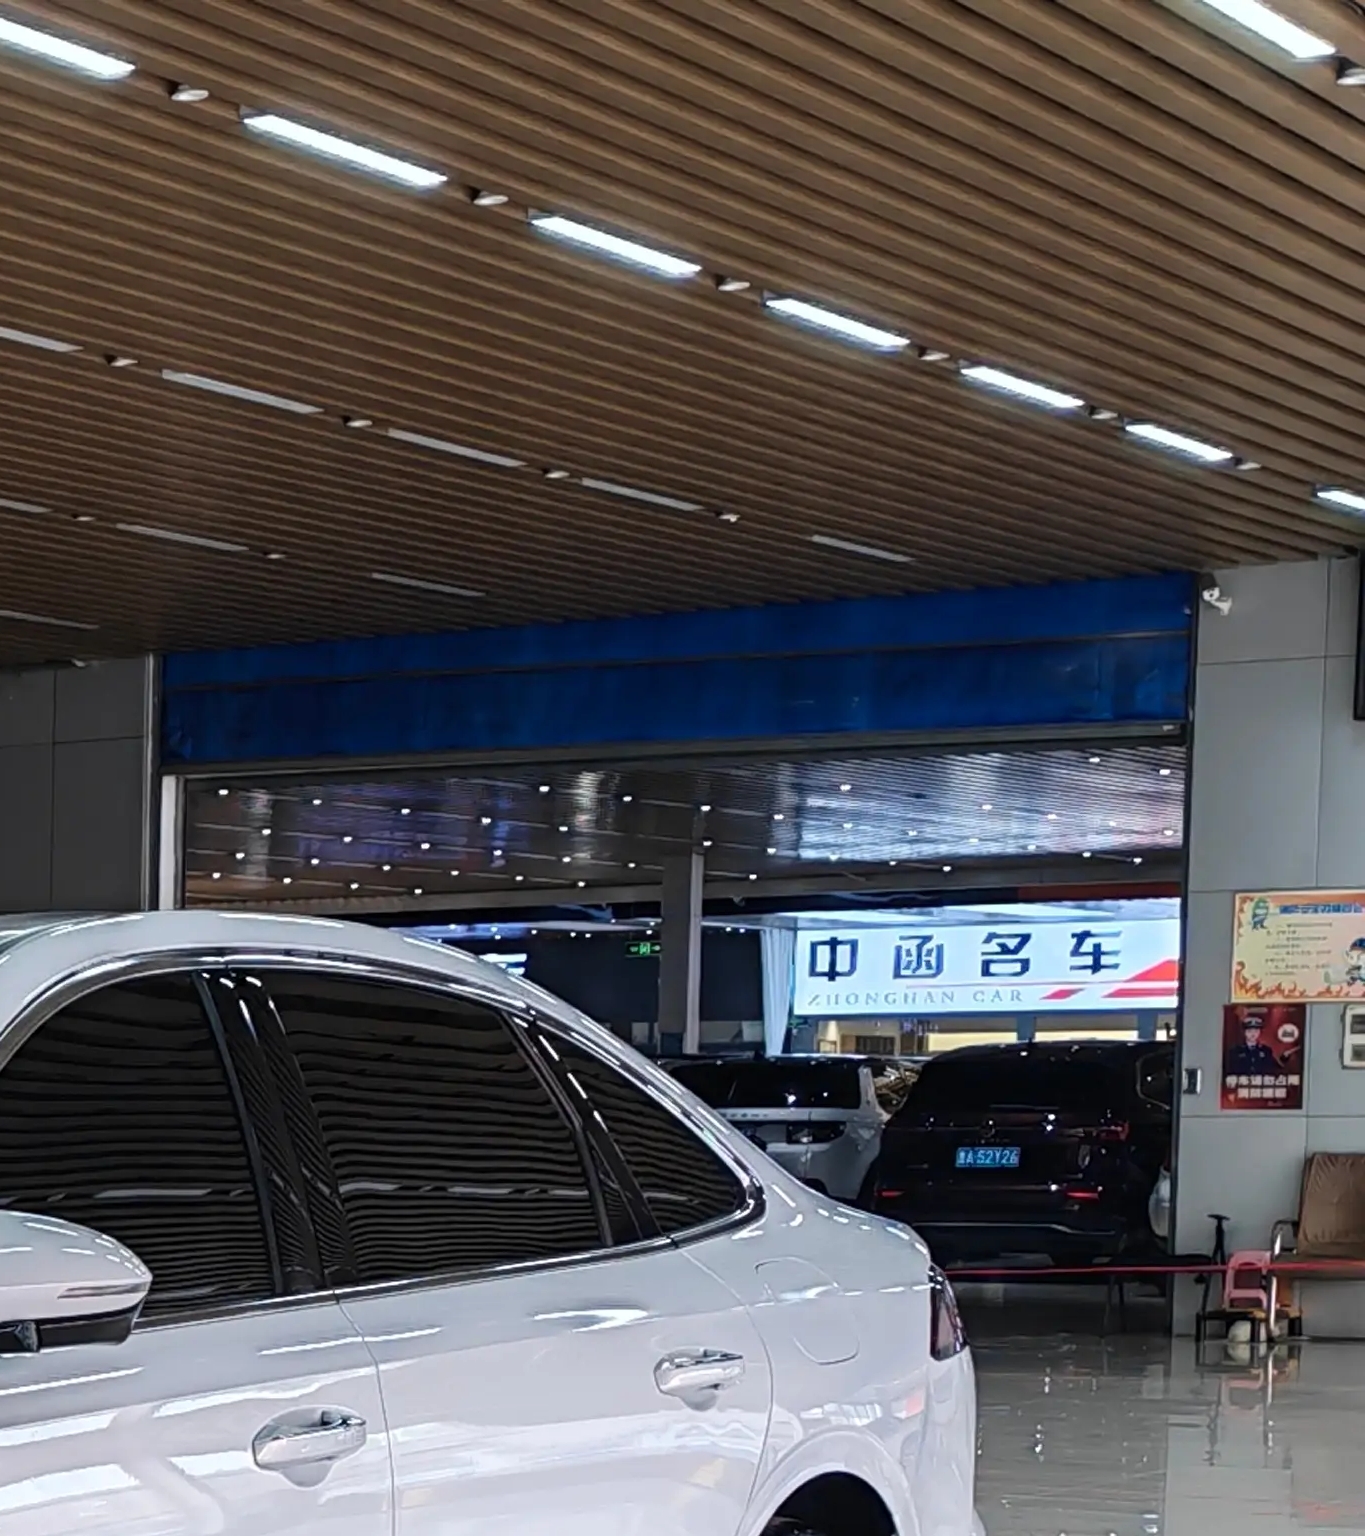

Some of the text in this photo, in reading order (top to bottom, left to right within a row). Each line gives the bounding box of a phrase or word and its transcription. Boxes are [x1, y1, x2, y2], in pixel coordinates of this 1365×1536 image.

[808, 929, 1122, 982] 中函名车
[808, 989, 1023, 1007] ZHONGHAN CAR
